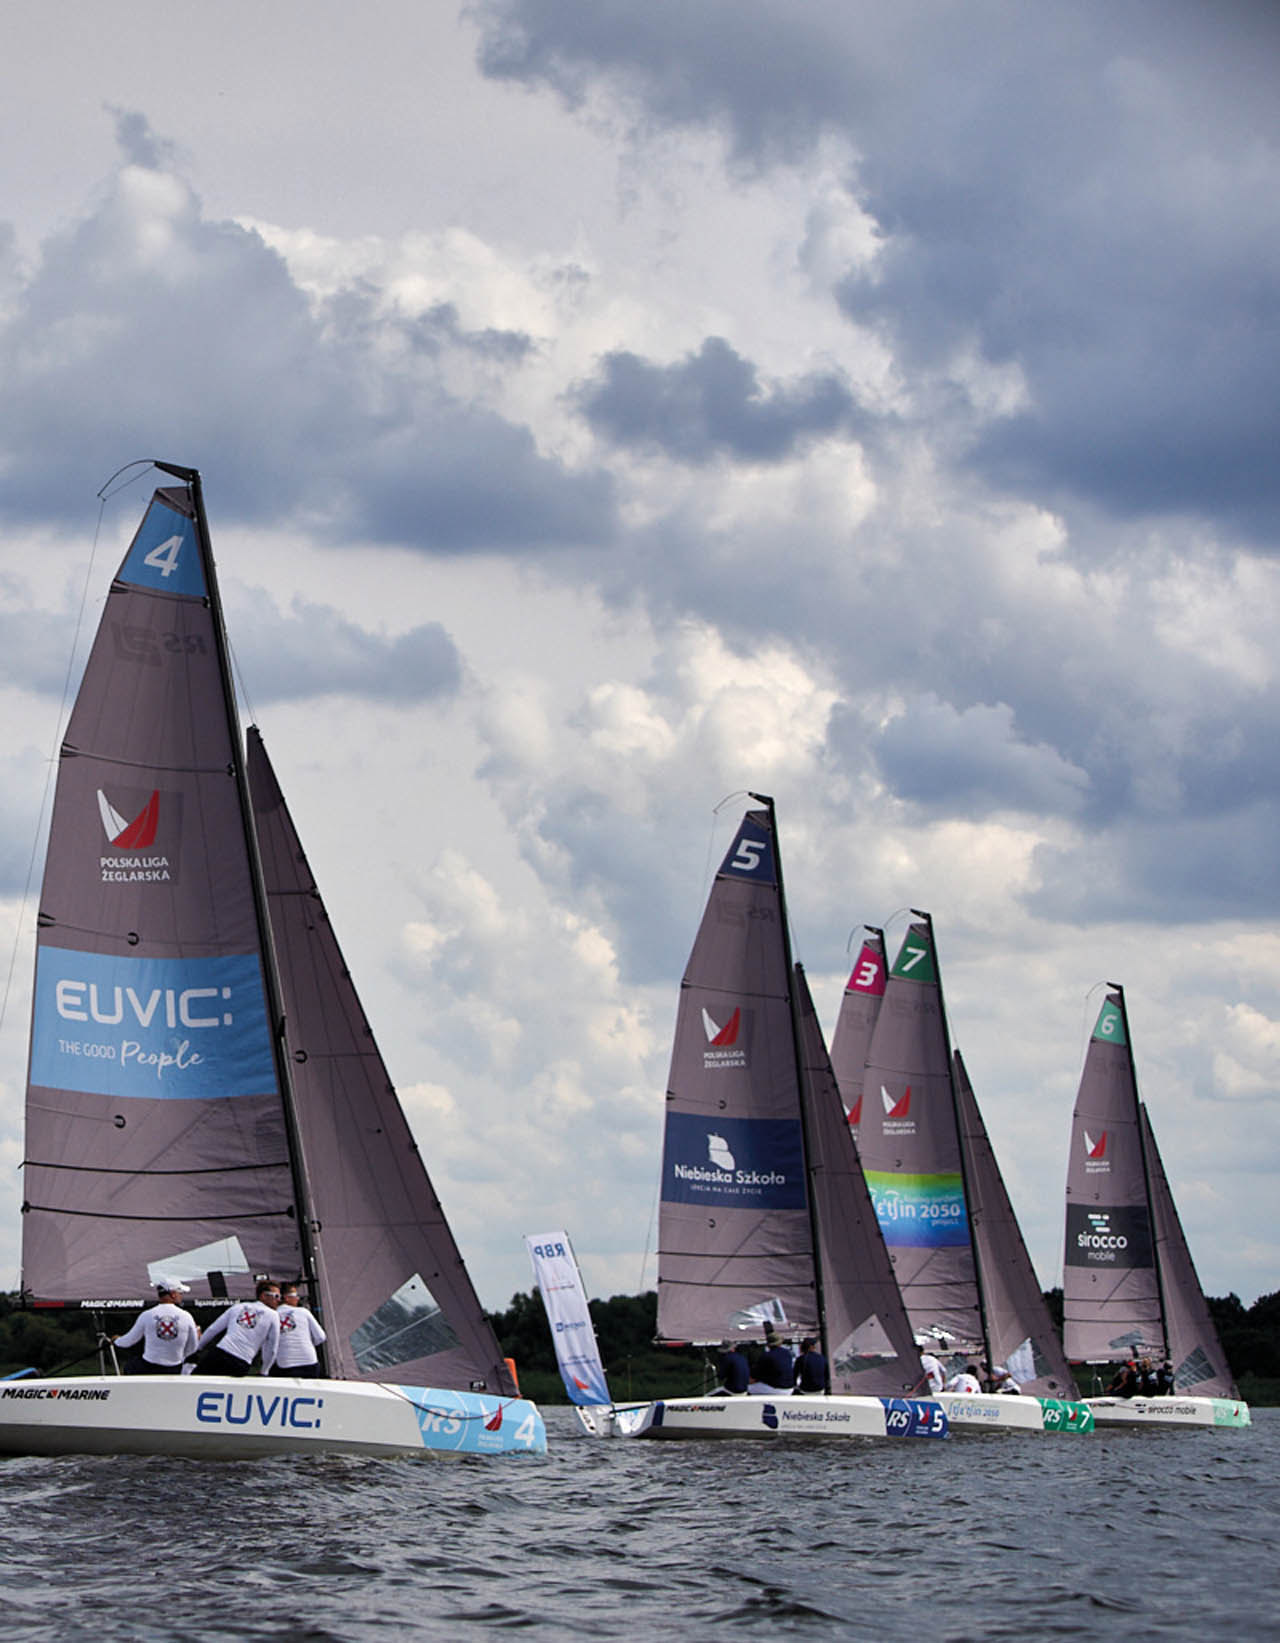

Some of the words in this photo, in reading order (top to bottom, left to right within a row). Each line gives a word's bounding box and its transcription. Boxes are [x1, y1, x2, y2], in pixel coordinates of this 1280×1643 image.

[144, 535, 184, 577] 4
[100, 856, 141, 868] POLSKA
[142, 856, 169, 868] LIGA
[731, 838, 766, 870] 5
[102, 868, 170, 881] ŻEGLARSKA
[902, 946, 926, 972] 7
[856, 961, 878, 987] 3
[1101, 1014, 1117, 1034] 6
[58, 1040, 81, 1056] THE
[83, 1043, 116, 1059] GOOD
[120, 1040, 204, 1080] People
[674, 1164, 733, 1184] Niebieska
[736, 1169, 786, 1185] Szkoła
[920, 1203, 961, 1218] 2050
[1078, 1231, 1128, 1249] sirocco
[1087, 1250, 1116, 1261] mobile
[1, 1388, 48, 1400] MAGIC
[57, 1389, 111, 1401] MARINE
[421, 1407, 465, 1435] RS
[888, 1410, 910, 1428] RS
[932, 1409, 944, 1432] 5
[1044, 1409, 1062, 1423] RS
[1080, 1411, 1090, 1429] 7
[514, 1413, 536, 1448] 4
